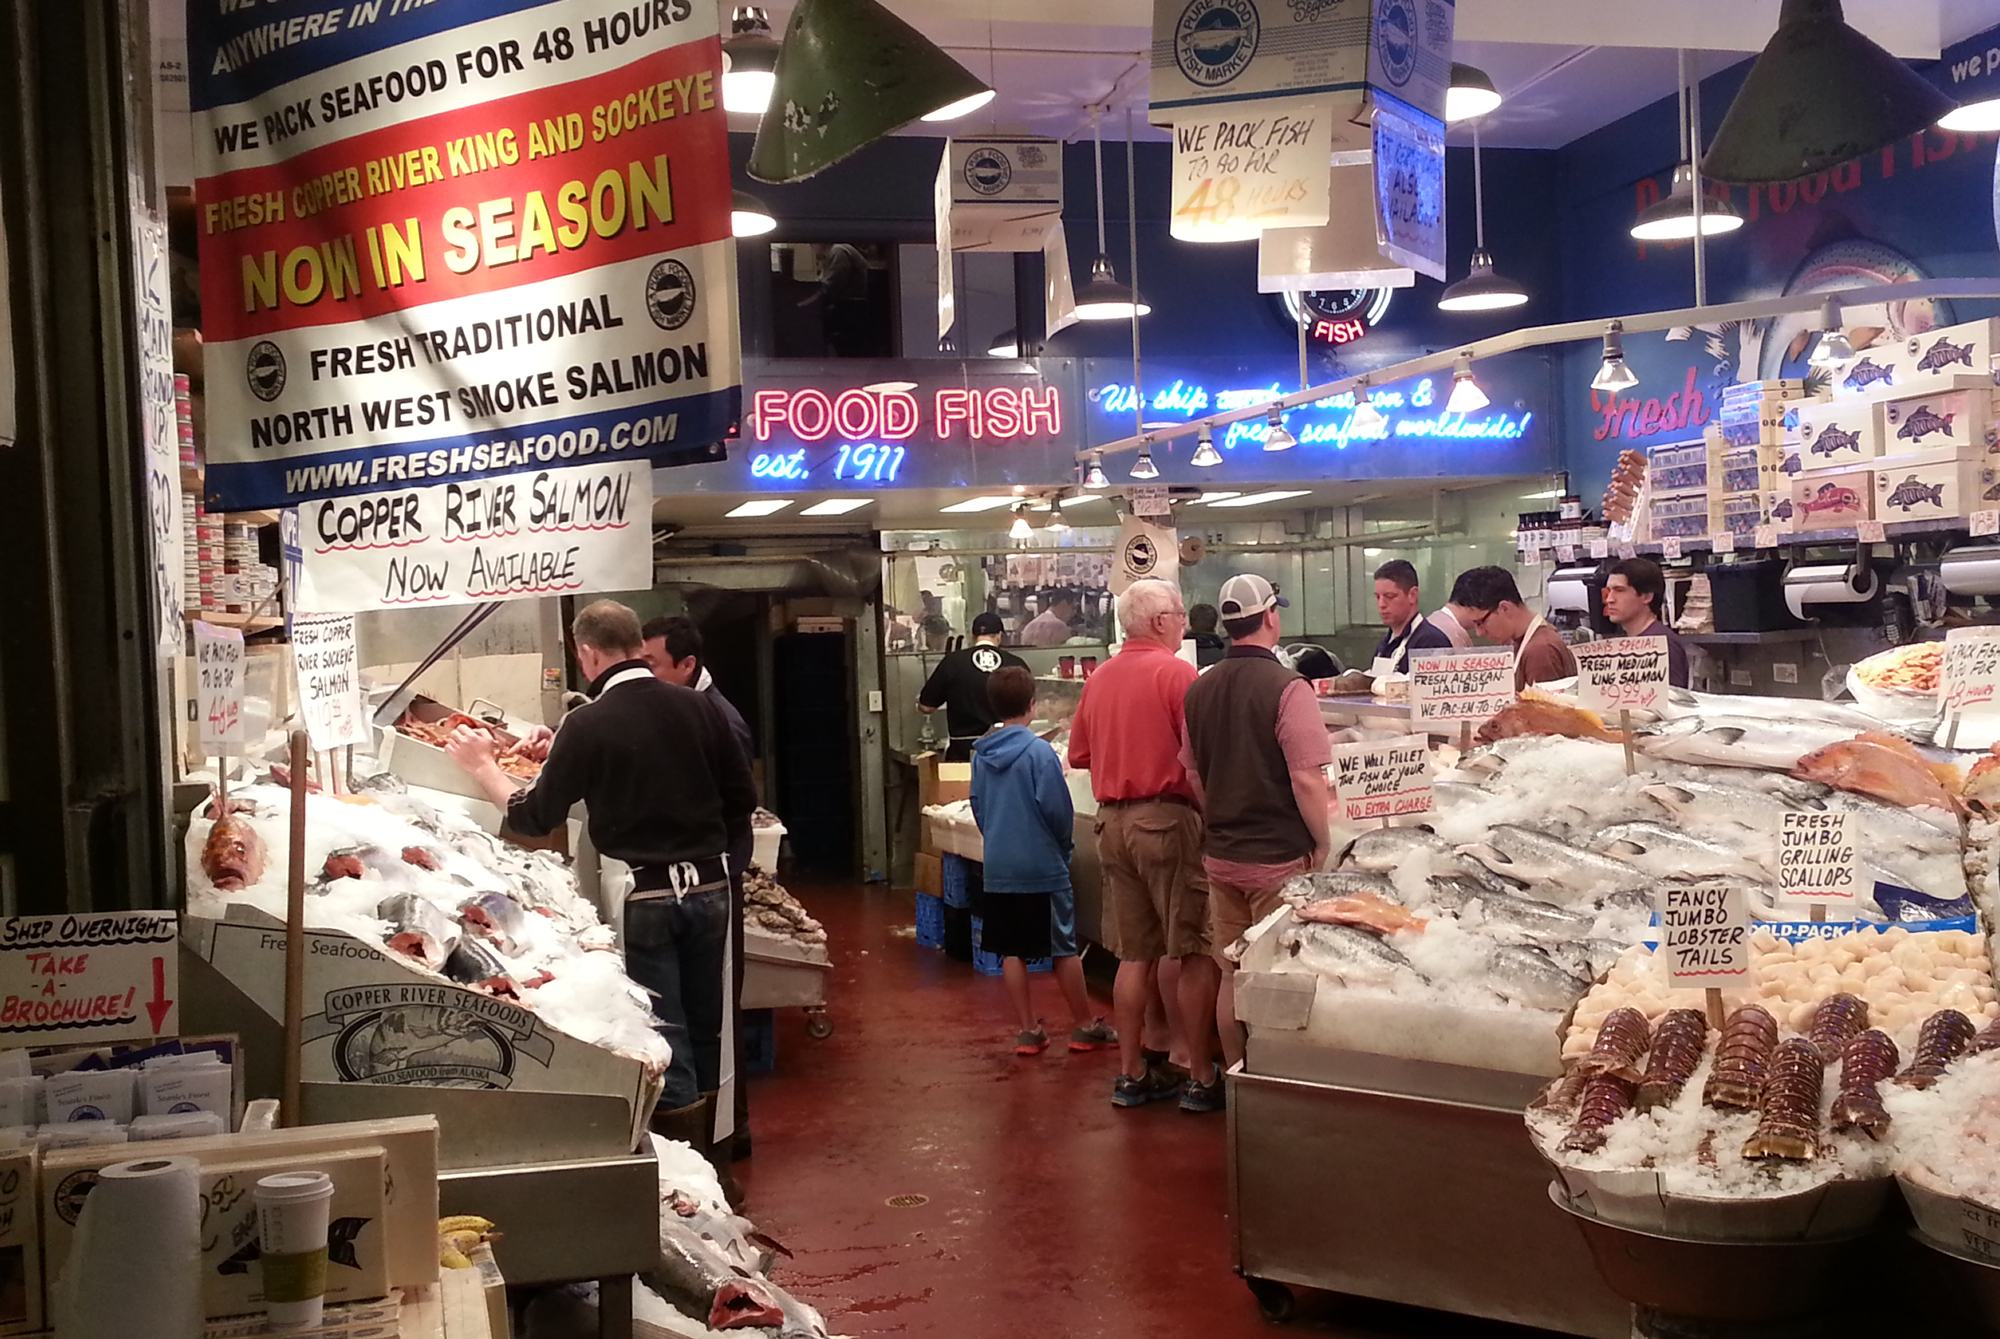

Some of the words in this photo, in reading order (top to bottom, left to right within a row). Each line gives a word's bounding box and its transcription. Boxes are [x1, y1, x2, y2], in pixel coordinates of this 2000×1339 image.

[1183, 0, 1213, 30] PURE
[211, 9, 343, 75] ANYWHERE
[347, 0, 381, 29] IN
[1181, 47, 1203, 77] FISH
[1205, 40, 1251, 80] MARKET
[1952, 55, 1981, 83] we
[214, 121, 258, 154] WE
[264, 98, 315, 144] PACK
[321, 59, 447, 122] SEAFOOD
[456, 40, 524, 84] FOR
[533, 26, 574, 63] 48
[584, 0, 692, 53] HOURS
[1178, 124, 1210, 154] WE
[1213, 118, 1264, 151] PACK
[1265, 116, 1315, 147] FISH
[206, 190, 286, 235] FRESH
[292, 167, 363, 218] COPPER
[366, 146, 443, 196] RIVER
[447, 128, 519, 176] KING
[529, 113, 584, 160] AND
[592, 71, 715, 142] SOCKEYE
[1189, 155, 1208, 181] TO
[1243, 148, 1280, 174] FOR
[1176, 177, 1241, 227] 48
[241, 233, 362, 313] NOW
[367, 217, 426, 289] IN
[442, 154, 673, 276] SEASON
[310, 336, 416, 380] FRESH
[415, 294, 624, 364] TRADITIONAL
[1315, 319, 1365, 343] FISH
[251, 404, 353, 448] NORTH
[362, 391, 451, 431] WEST
[458, 372, 559, 419] SMOKE
[566, 342, 708, 401] SALMON
[1101, 382, 1145, 412] We
[1153, 379, 1208, 416] ship
[1411, 378, 1433, 407] &
[754, 388, 919, 441] FOOD
[935, 385, 1062, 439] FISH
[1395, 411, 1532, 440] worldwide!
[285, 413, 678, 494] WWW.FRESHSEAFOOD.COM
[751, 449, 810, 479] est.
[833, 443, 905, 481] 1911
[317, 493, 422, 545] COPPER
[444, 484, 516, 537] RIVER
[529, 471, 632, 526] SALMON
[386, 556, 450, 598] NOW
[467, 546, 580, 589] AVAILABLE
[294, 629, 319, 645] FRESH
[323, 623, 353, 643] COPPER
[1575, 639, 1613, 654] TODAY'S
[1618, 637, 1658, 652] SPECIAL
[298, 652, 319, 672] RIVER
[322, 645, 354, 671] SOCKEYE
[1446, 660, 1457, 671] IN
[1580, 660, 1612, 672] FRESH
[1616, 656, 1659, 672] MEDIUM
[1969, 660, 1998, 676] FOR
[310, 670, 349, 700] SALMON
[1414, 674, 1448, 686] FRESH
[1432, 682, 1488, 696] HALIBUT
[1591, 672, 1616, 686] KING
[1618, 667, 1667, 685] SALMON
[208, 695, 227, 736] 48
[1420, 703, 1437, 718] WE
[1338, 756, 1360, 773] WE
[1364, 753, 1384, 769] WILL
[1388, 749, 1425, 766] FILLET
[1338, 774, 1355, 787] THE
[1357, 770, 1380, 785] FISH
[1382, 767, 1396, 780] OF
[1398, 763, 1426, 782] YOUR
[1364, 780, 1401, 796] CHOICE
[1346, 803, 1362, 818] NO
[1365, 801, 1391, 816] EXTRA
[1394, 795, 1433, 813] CHARGE
[1784, 813, 1846, 828] FRESH
[1781, 830, 1843, 847] JUMBO
[1780, 847, 1854, 866] GRILLING
[1779, 867, 1853, 889] SCALLOPS
[1667, 888, 1729, 910] FANCY
[3, 916, 53, 942] SHIP
[60, 916, 178, 939] OVERNIGHT
[1665, 908, 1728, 927] JUMBO
[1667, 926, 1745, 947] LOBSTER
[26, 952, 90, 975] TAKE
[1676, 948, 1734, 968] TAILS
[1, 986, 136, 1023] BROCHURE!
[332, 988, 392, 1012] COPPER
[400, 987, 446, 1004] RIVER
[454, 992, 529, 1030] SEAFOODS
[397, 1066, 437, 1080] SEAFOOD
[459, 1067, 491, 1081] ALASKA
